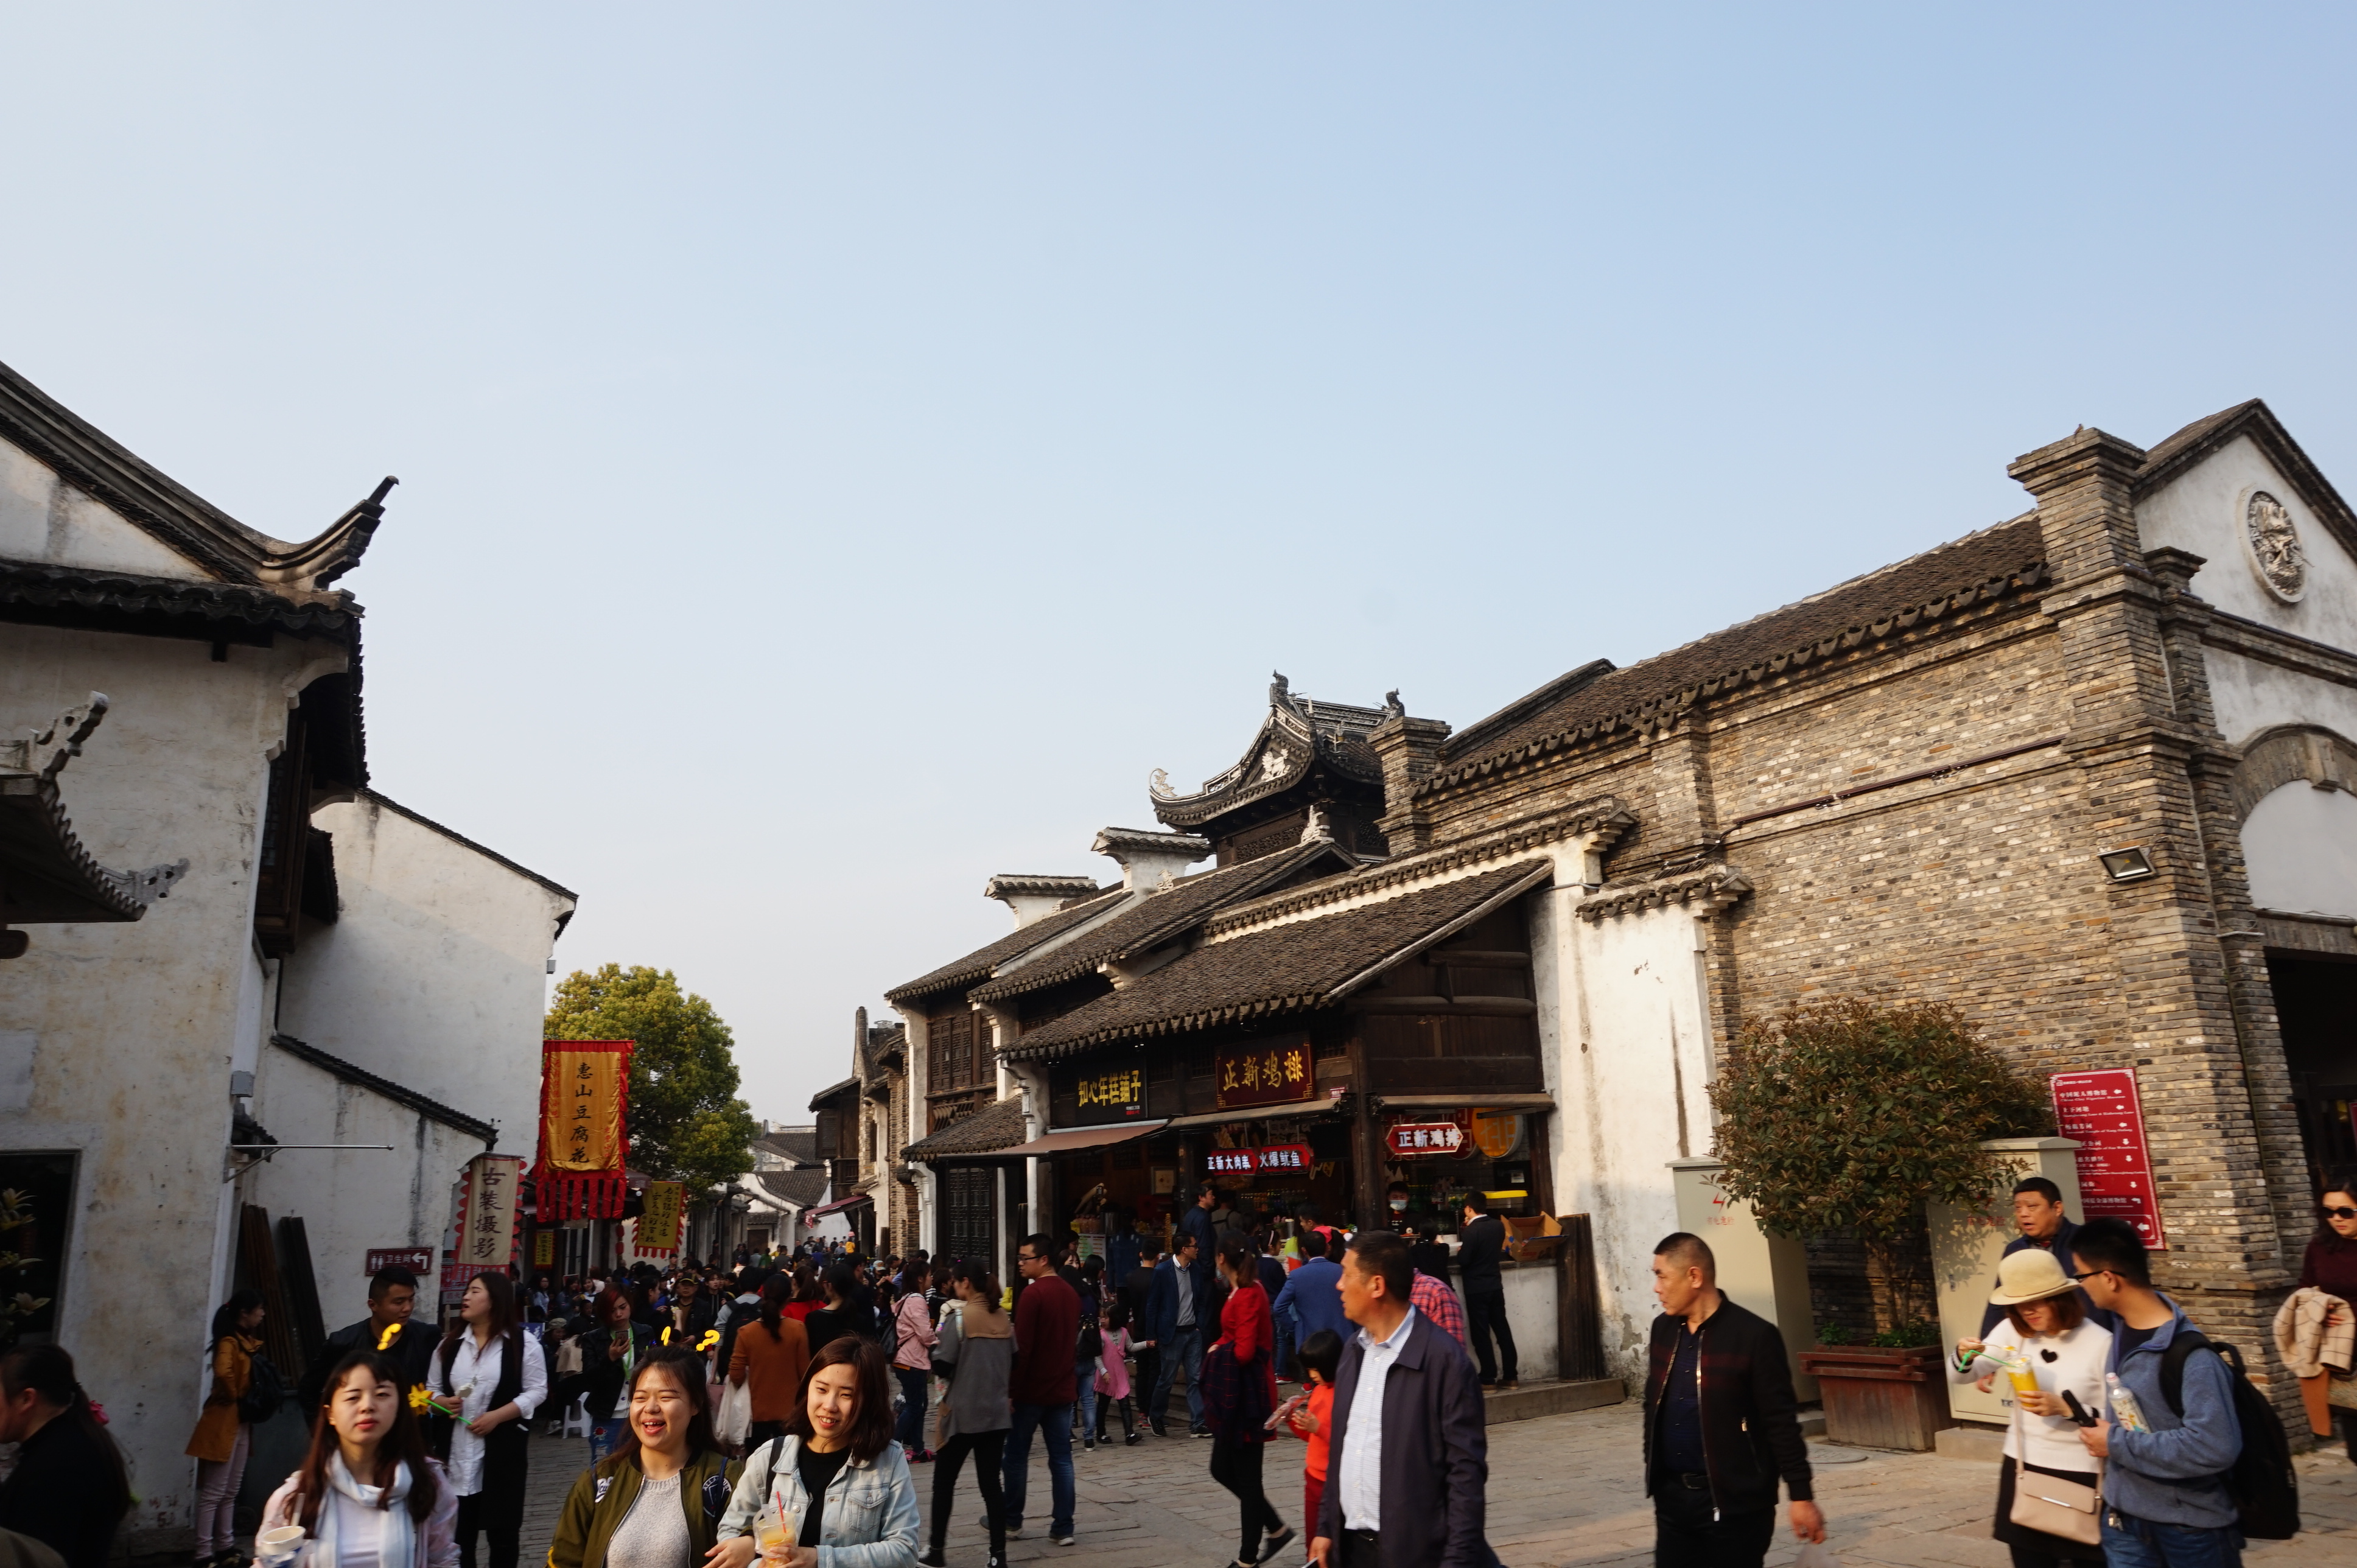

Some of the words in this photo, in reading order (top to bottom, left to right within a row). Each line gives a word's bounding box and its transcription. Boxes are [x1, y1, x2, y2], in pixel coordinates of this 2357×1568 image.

[1223, 1049, 1304, 1091] 正新鸡排
[569, 1062, 594, 1163] 惠山豆腐花
[1398, 1129, 1460, 1148] 正新鸡排
[1259, 1150, 1301, 1167] 火爆鱿鱼
[472, 1167, 506, 1258] 古装摄影
[385, 1254, 411, 1263] 卫生间
